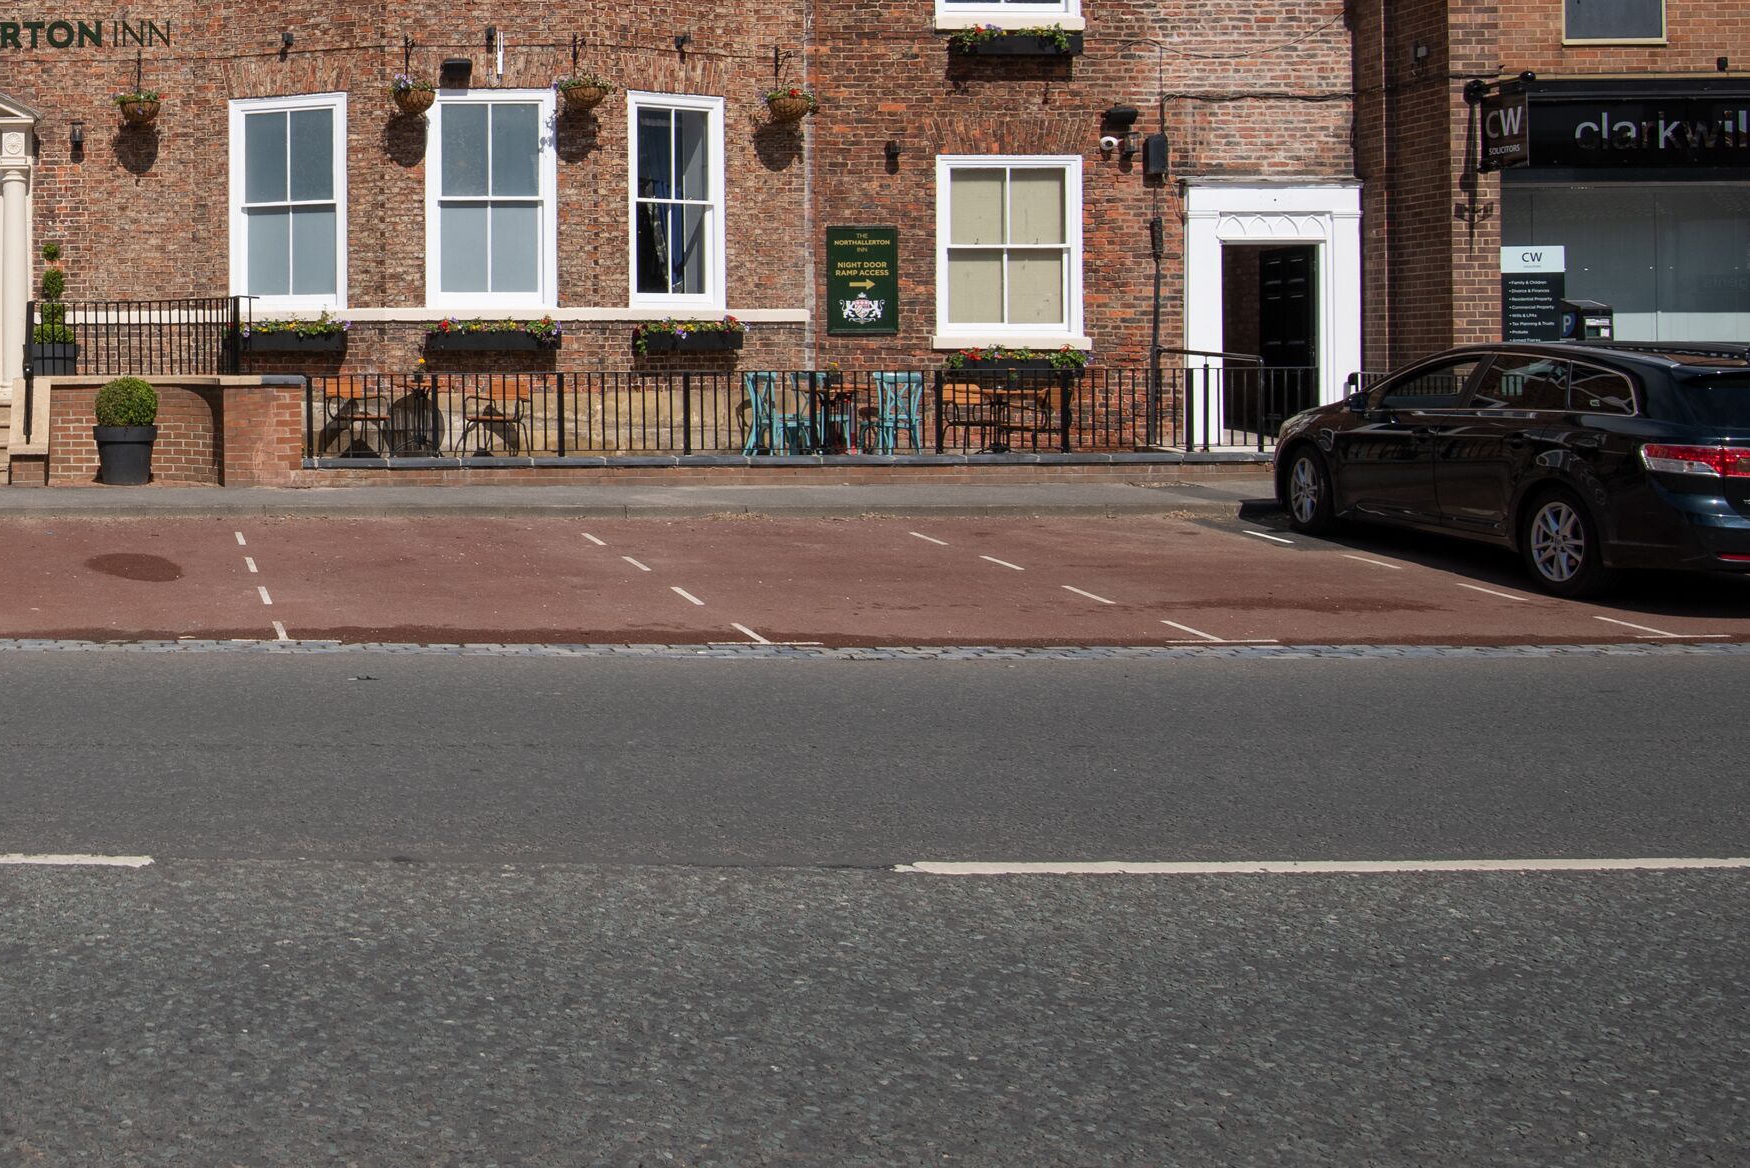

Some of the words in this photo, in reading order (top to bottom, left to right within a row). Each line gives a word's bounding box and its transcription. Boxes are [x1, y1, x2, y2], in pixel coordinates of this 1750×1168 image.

[113, 19, 172, 49] INN
[1485, 105, 1523, 139] CW
[1489, 144, 1521, 156] SOLICITORS
[1521, 251, 1543, 263] CW
